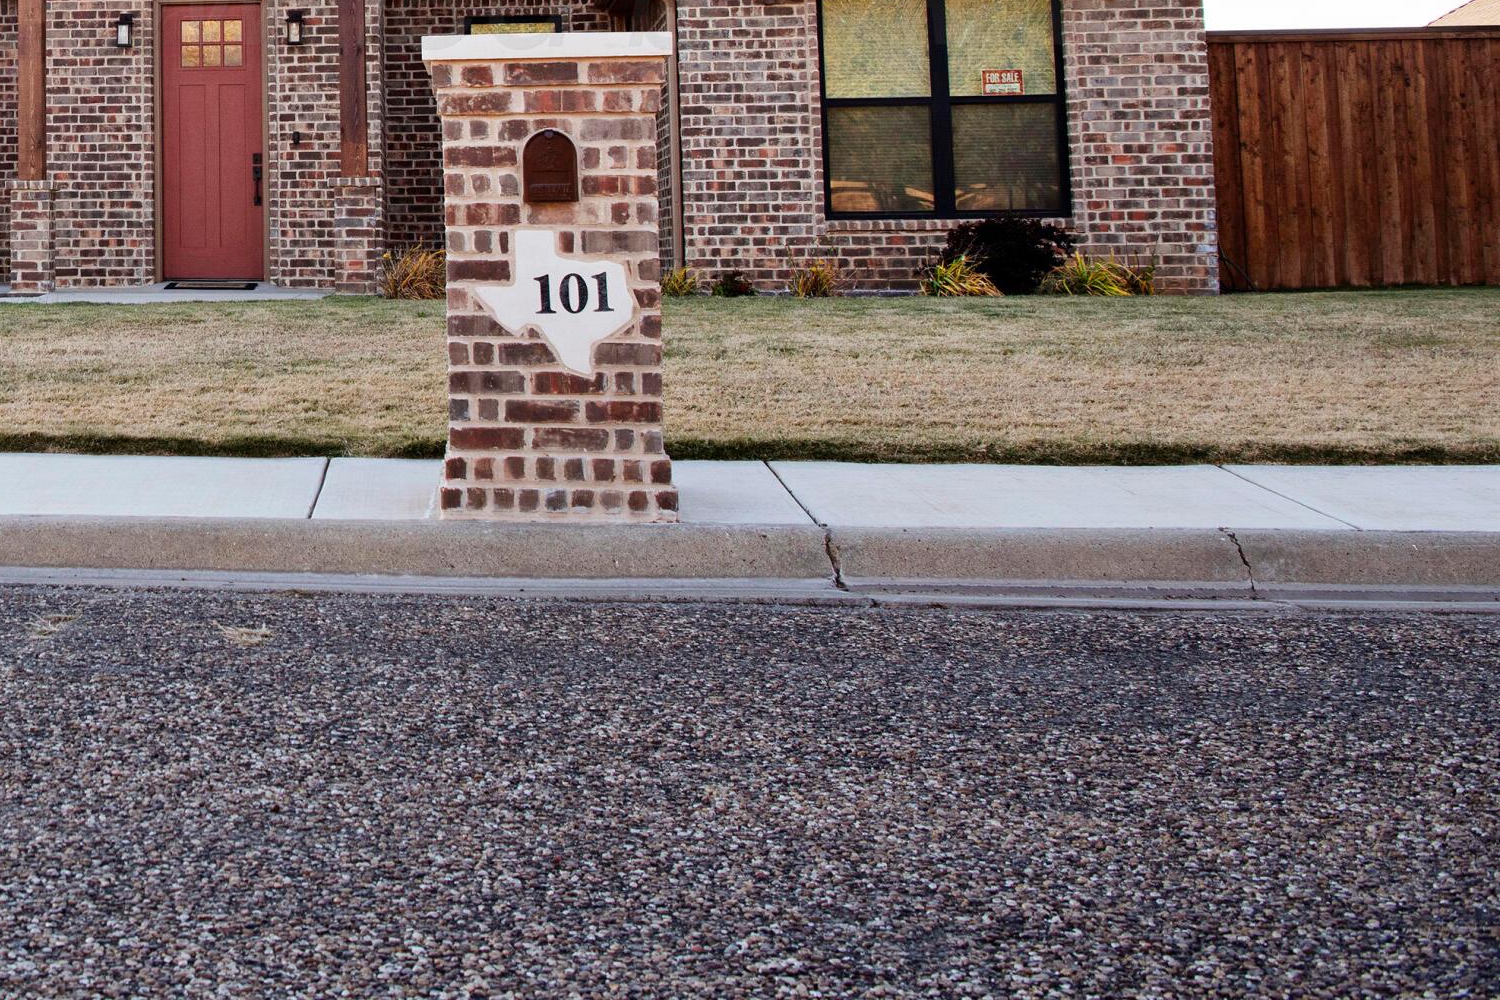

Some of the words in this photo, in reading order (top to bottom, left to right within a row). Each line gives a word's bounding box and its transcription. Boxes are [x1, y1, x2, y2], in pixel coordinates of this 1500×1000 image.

[985, 72, 1000, 83] FOR
[1001, 72, 1019, 83] SALE
[533, 271, 615, 314] 101
